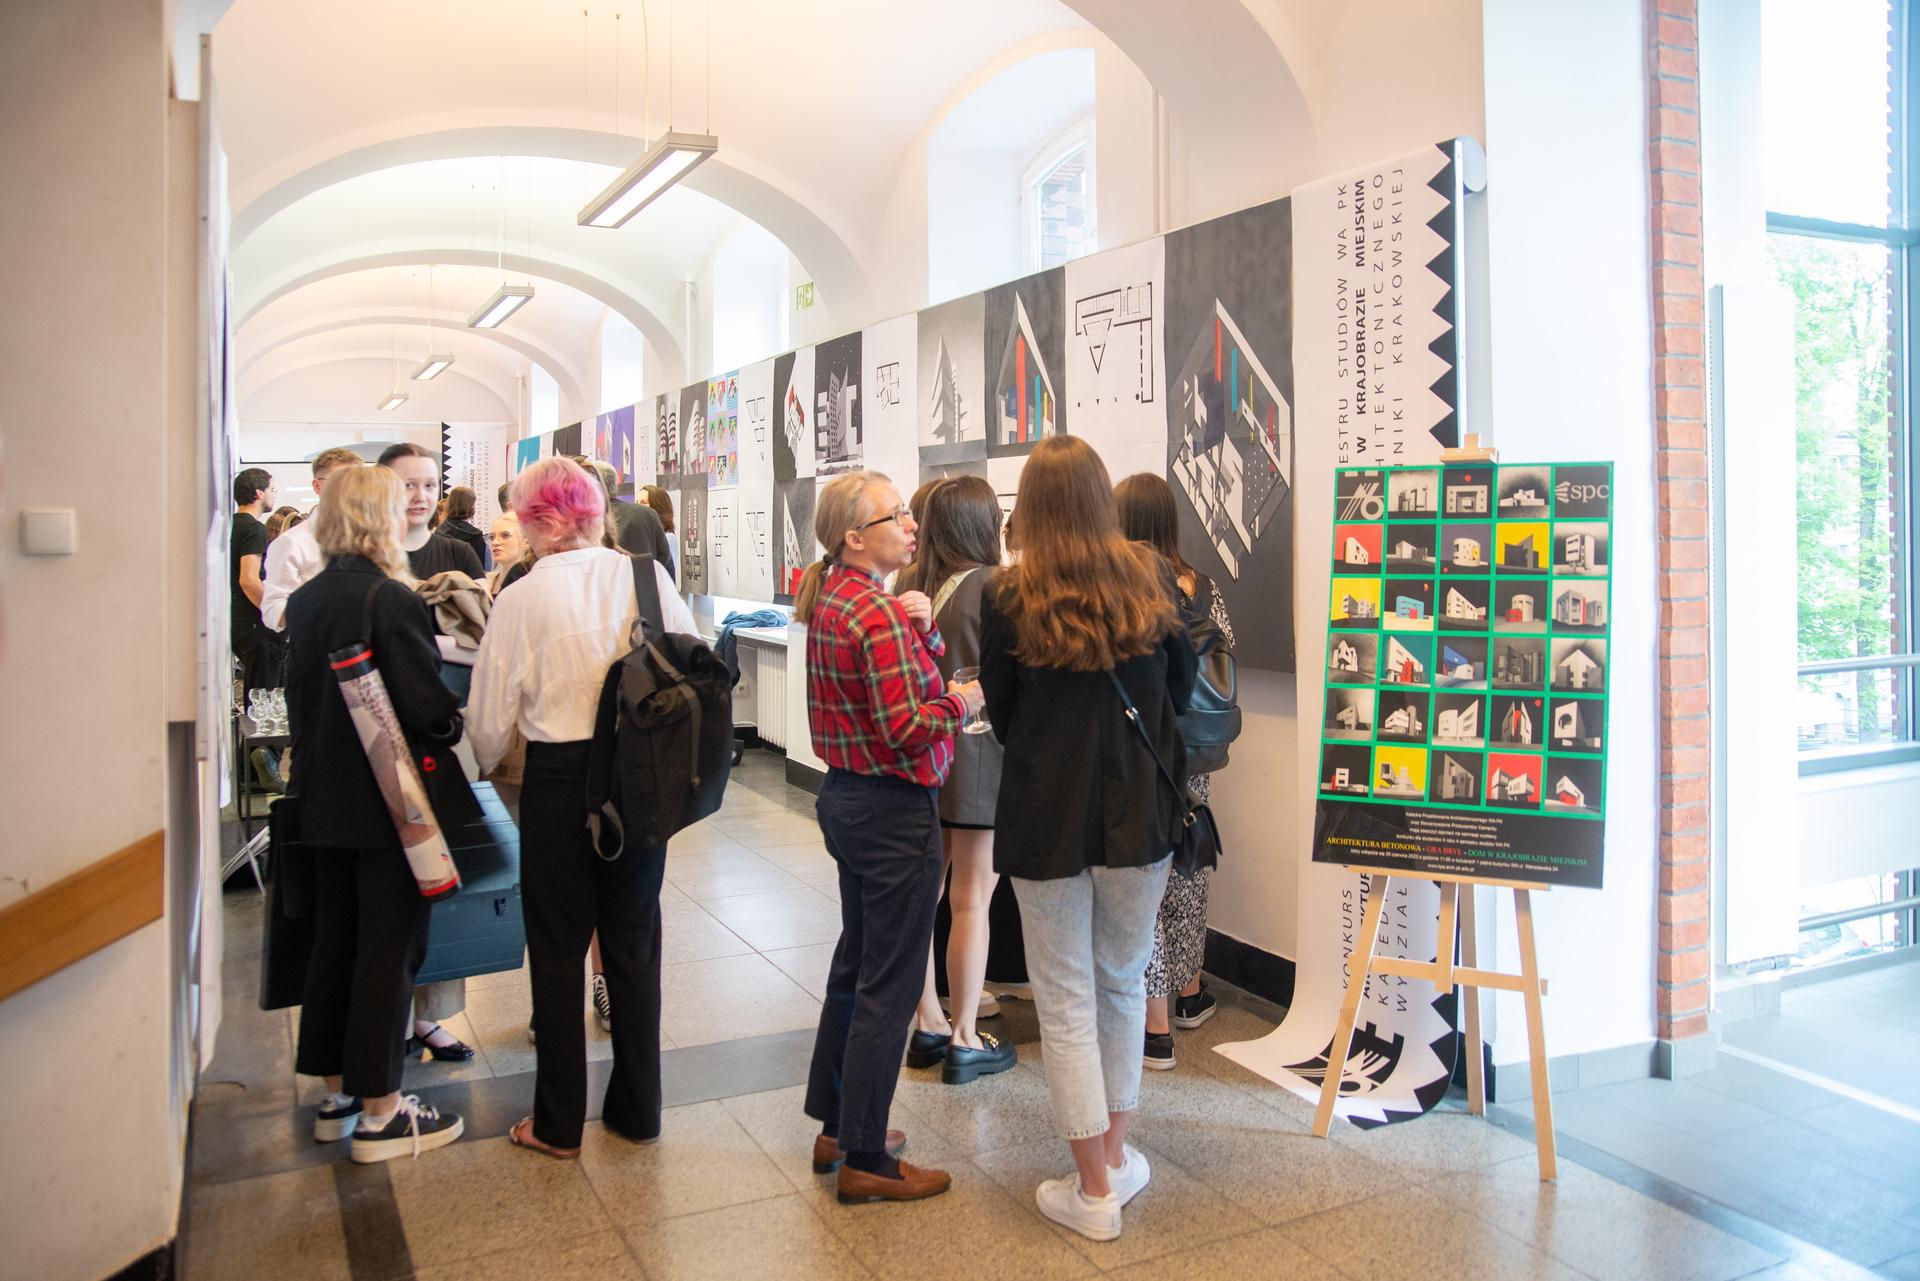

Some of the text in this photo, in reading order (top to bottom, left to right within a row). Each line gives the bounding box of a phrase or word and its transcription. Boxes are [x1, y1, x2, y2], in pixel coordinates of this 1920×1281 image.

[1336, 183, 1349, 464] ESTRU STUDIÓW WA PK
[1354, 179, 1367, 454] W KRAJOBRAZIE MIEJSKIM
[1391, 168, 1403, 364] KRAKOWSKIEJ
[1570, 484, 1609, 503] spc
[1326, 836, 1380, 848] ARCHITEKTURA
[1381, 840, 1421, 852] BETONOWA
[1396, 887, 1408, 1012] WYZIAŁ
